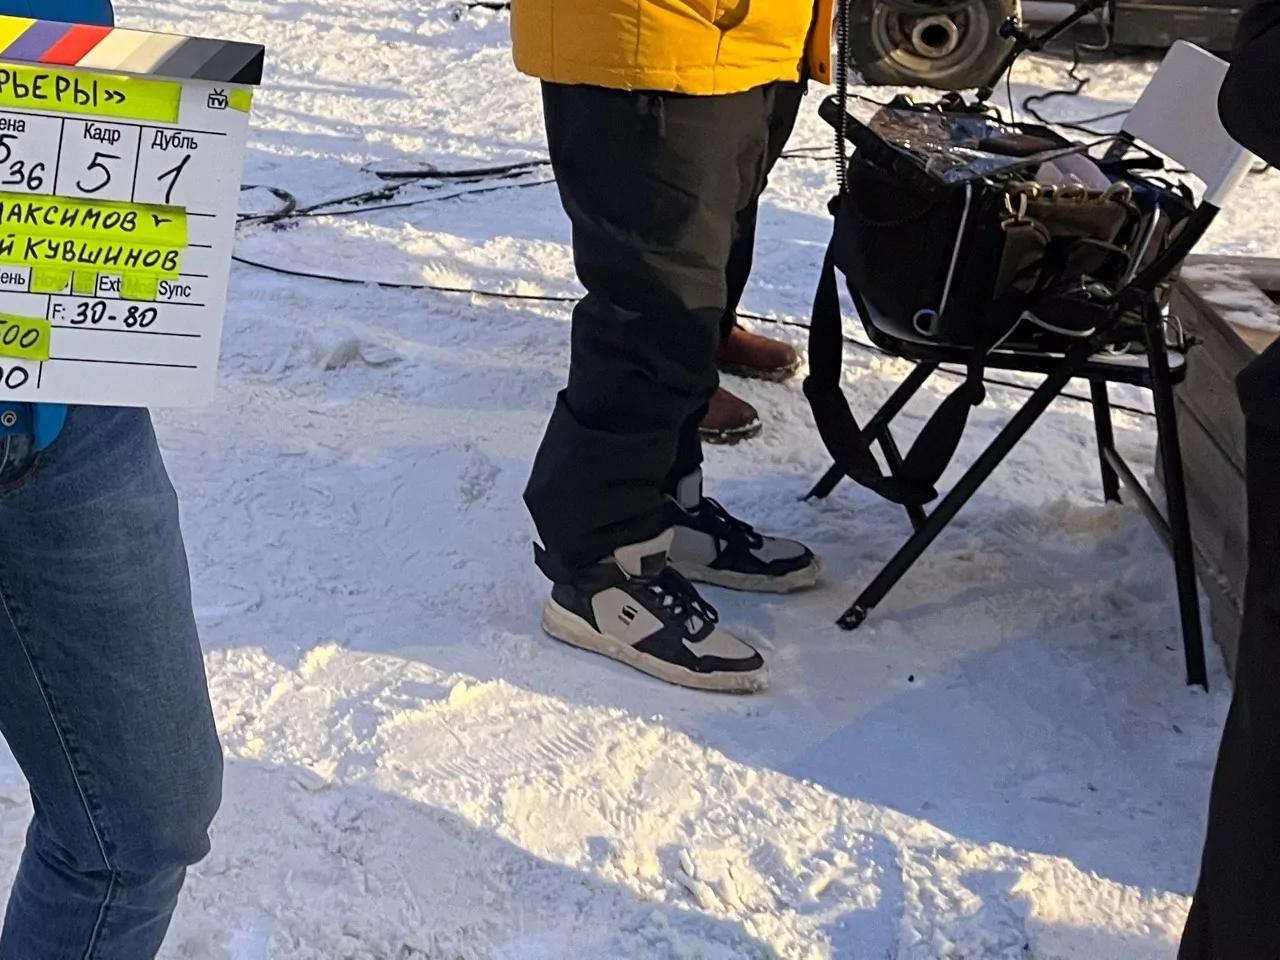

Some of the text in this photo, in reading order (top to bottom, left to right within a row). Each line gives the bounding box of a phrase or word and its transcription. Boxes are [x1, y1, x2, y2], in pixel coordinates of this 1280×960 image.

[83, 122, 121, 146] Кадр
[151, 129, 199, 151] Дубль
[76, 151, 121, 193] 5
[157, 153, 191, 204] 1
[23, 237, 180, 271] КУВШИНОВ
[99, 275, 121, 292] Ext
[158, 279, 192, 299] Sync
[52, 303, 66, 320] F:
